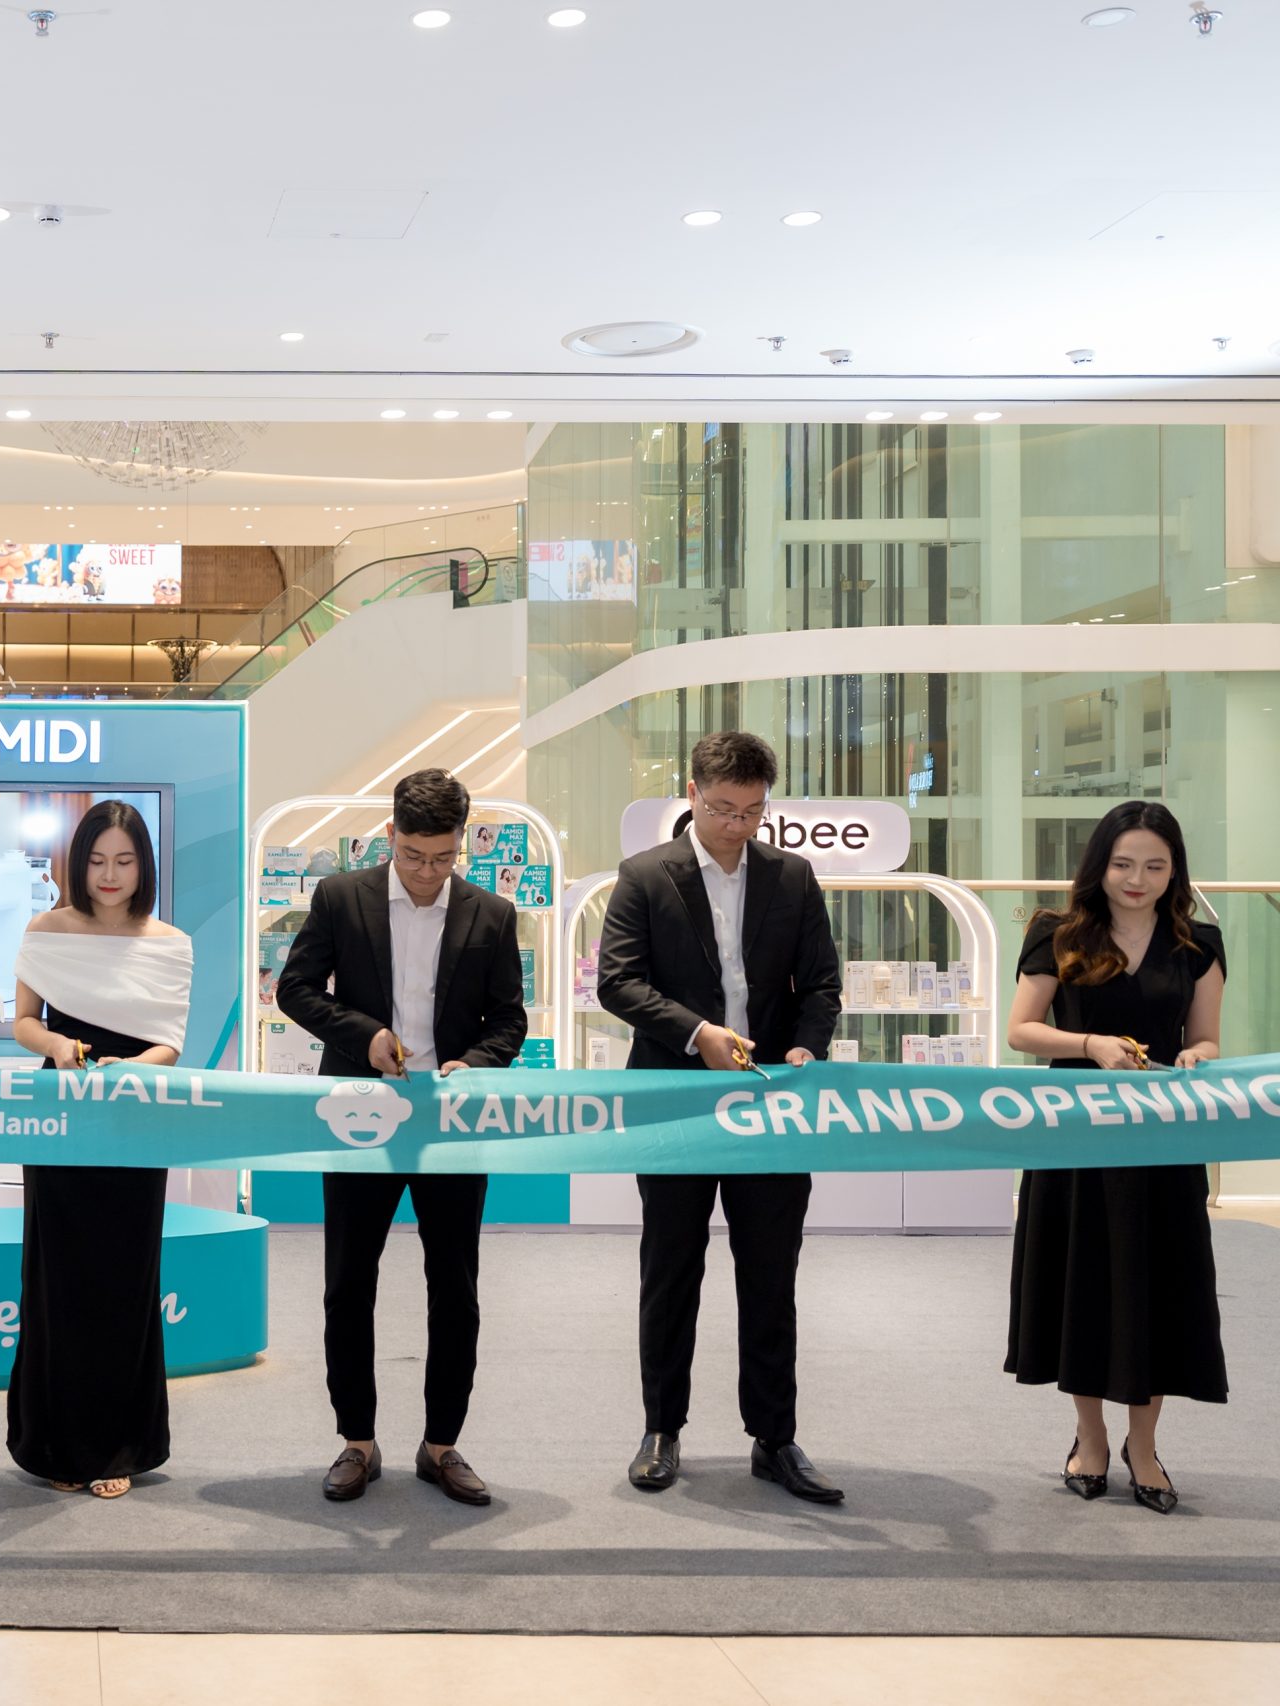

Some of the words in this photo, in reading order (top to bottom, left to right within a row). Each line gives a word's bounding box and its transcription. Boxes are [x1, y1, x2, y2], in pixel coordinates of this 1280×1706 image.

[109, 548, 156, 566] SWEET
[58, 1069, 223, 1108] MALL
[439, 1092, 626, 1134] KAMIDI
[714, 1088, 965, 1137] GRAND
[980, 1074, 1280, 1129] OPENING
